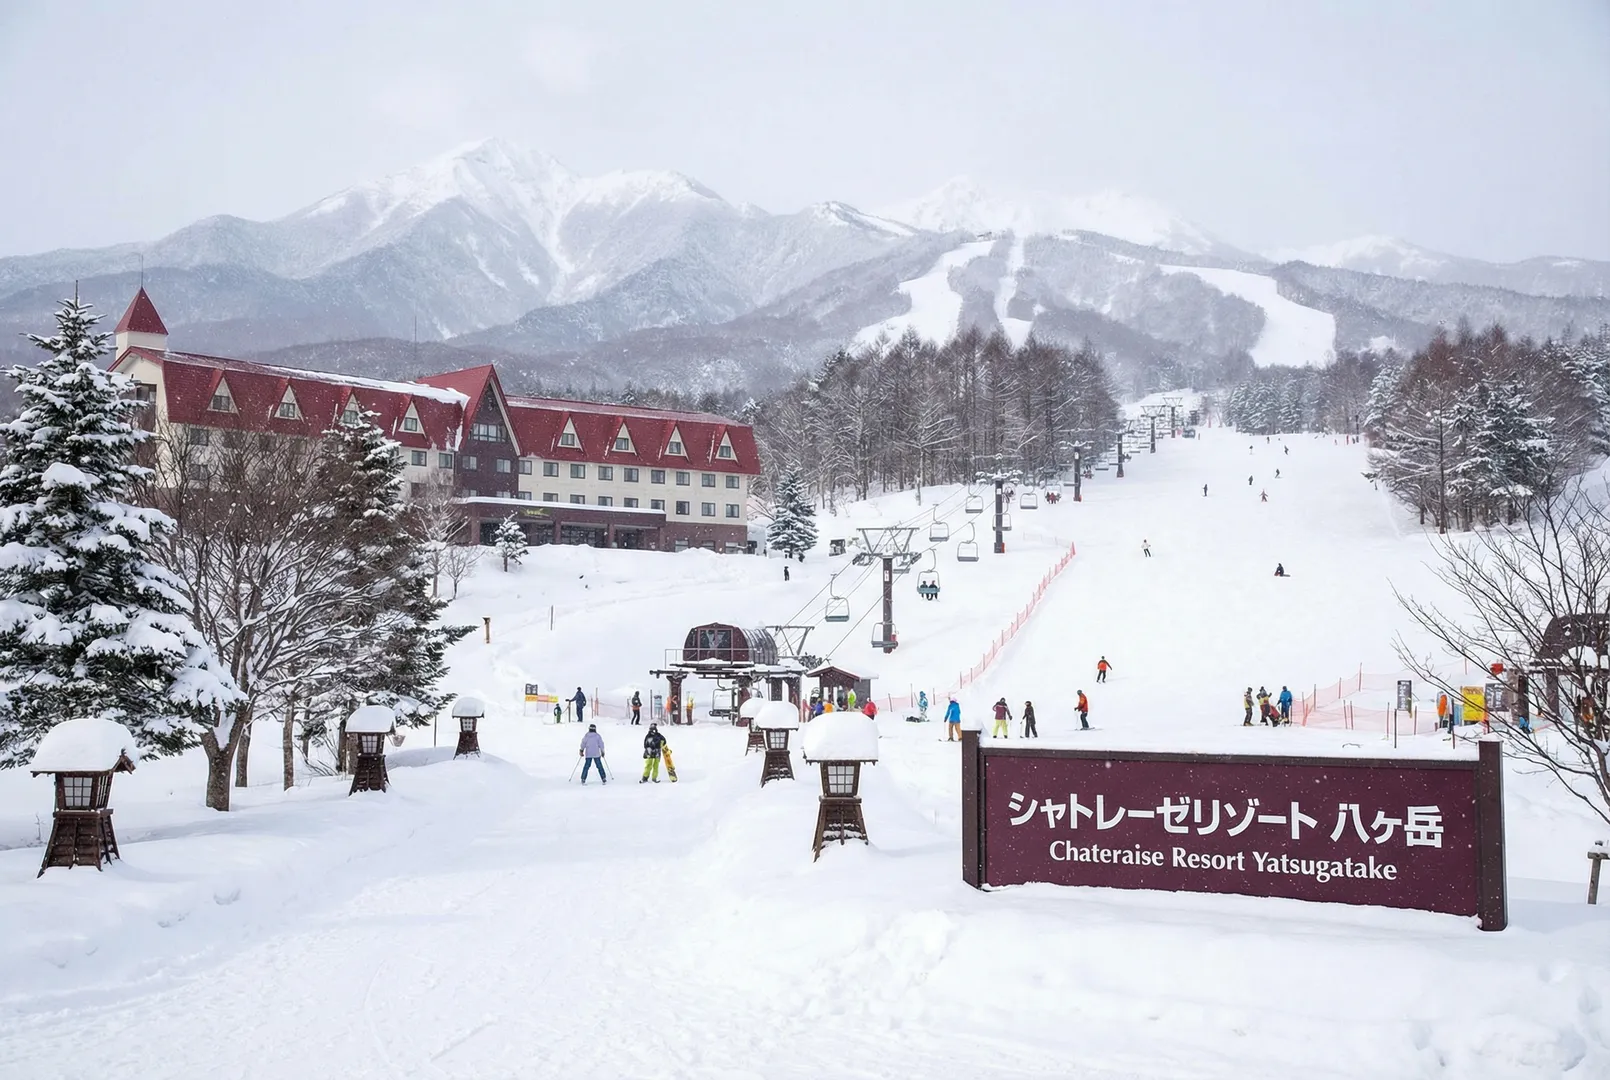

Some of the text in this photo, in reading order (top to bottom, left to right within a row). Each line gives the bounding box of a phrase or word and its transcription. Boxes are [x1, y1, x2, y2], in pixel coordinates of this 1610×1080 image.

[1009, 791, 1317, 839] シャトレーゼリゾート
[1049, 840, 1398, 883] Chateraise Resort Yatsugatake
